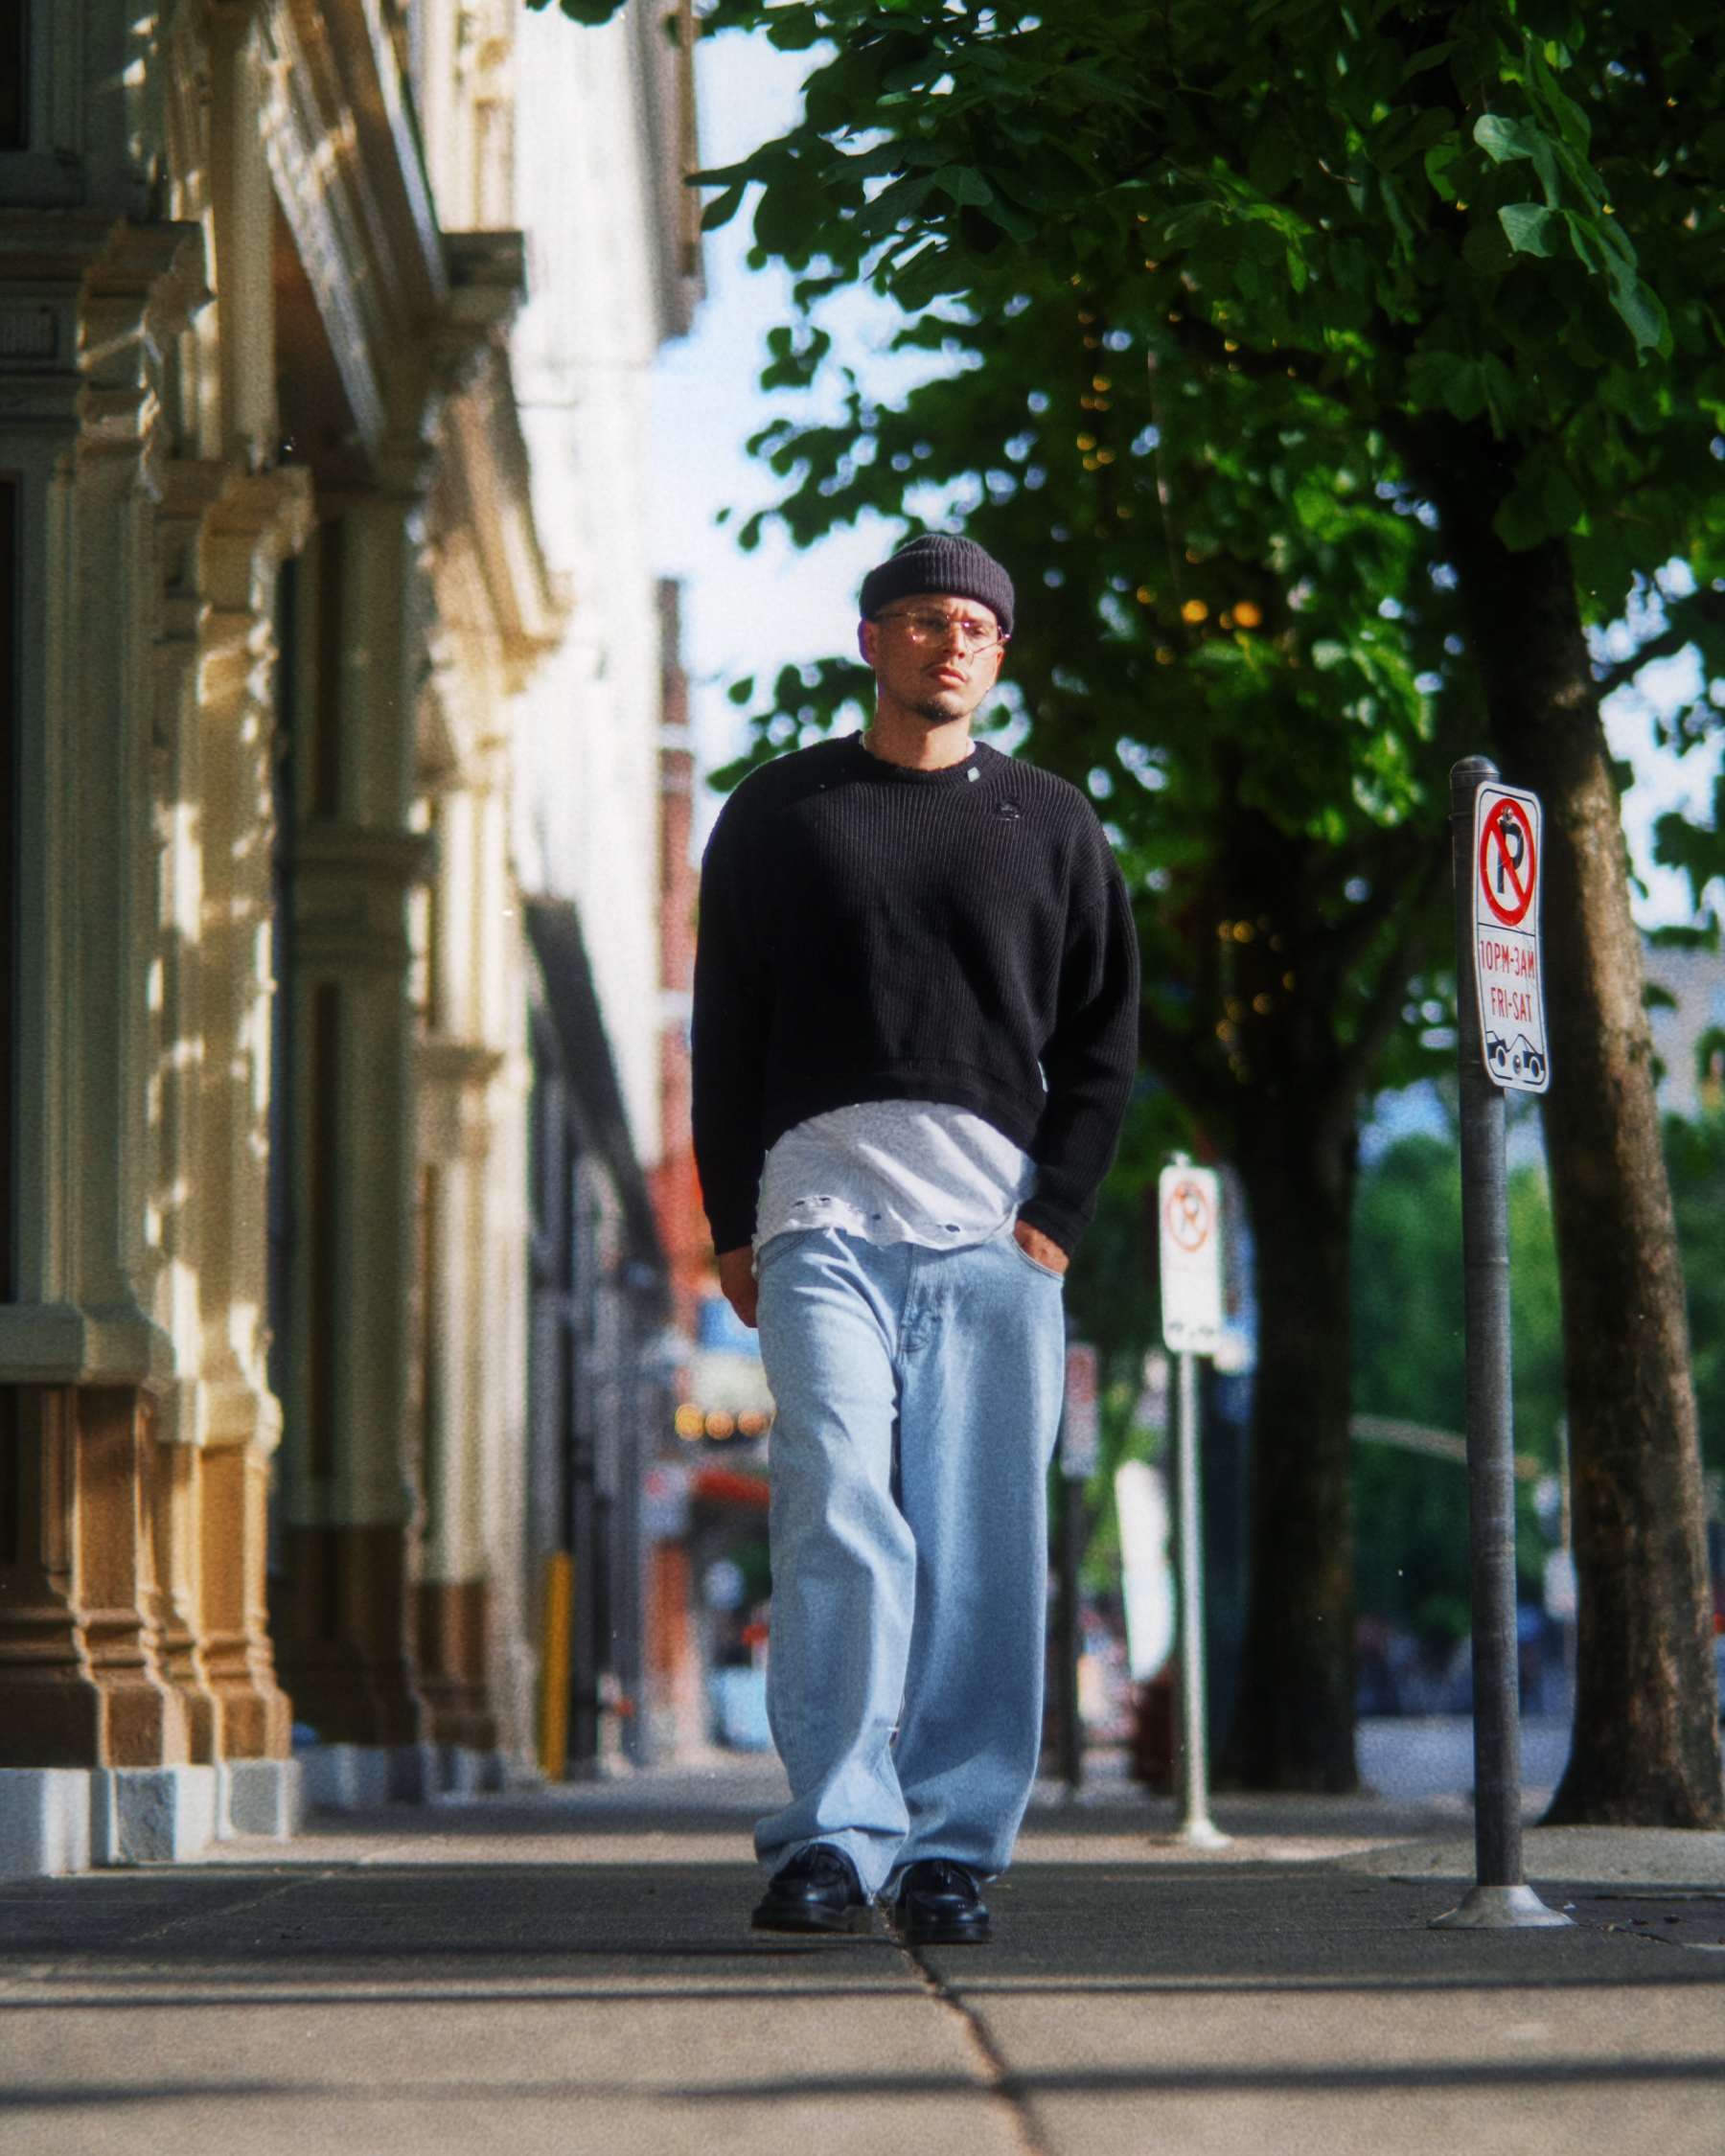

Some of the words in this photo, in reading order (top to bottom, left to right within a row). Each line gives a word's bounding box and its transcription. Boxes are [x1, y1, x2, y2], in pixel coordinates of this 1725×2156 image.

[1497, 819, 1524, 894] P
[1481, 940, 1535, 979] 10PM-3AM
[1491, 986, 1531, 1022] FRI-SAT
